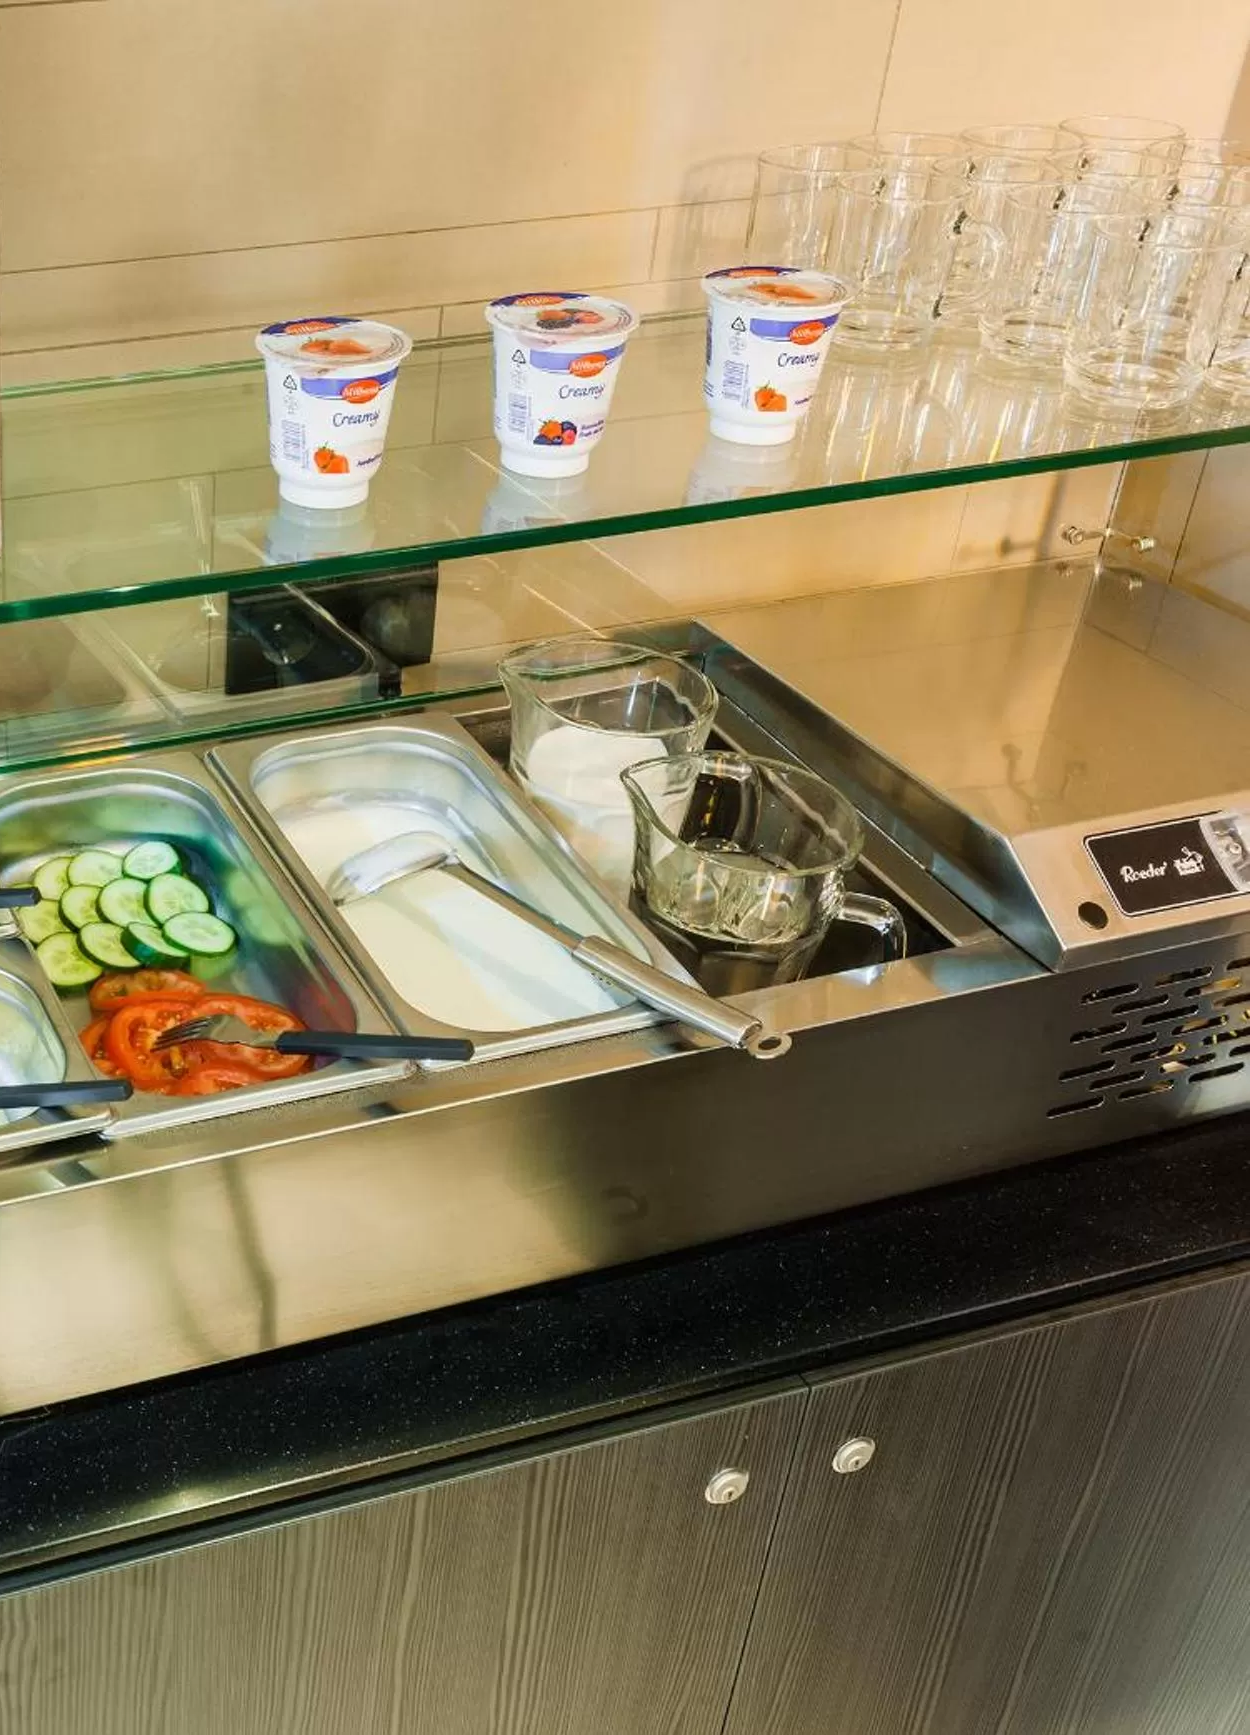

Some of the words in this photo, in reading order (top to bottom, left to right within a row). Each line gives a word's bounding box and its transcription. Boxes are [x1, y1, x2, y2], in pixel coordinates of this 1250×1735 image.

[777, 352, 820, 368] Creamy
[559, 384, 606, 400] Creamy
[333, 409, 381, 428] Creamy
